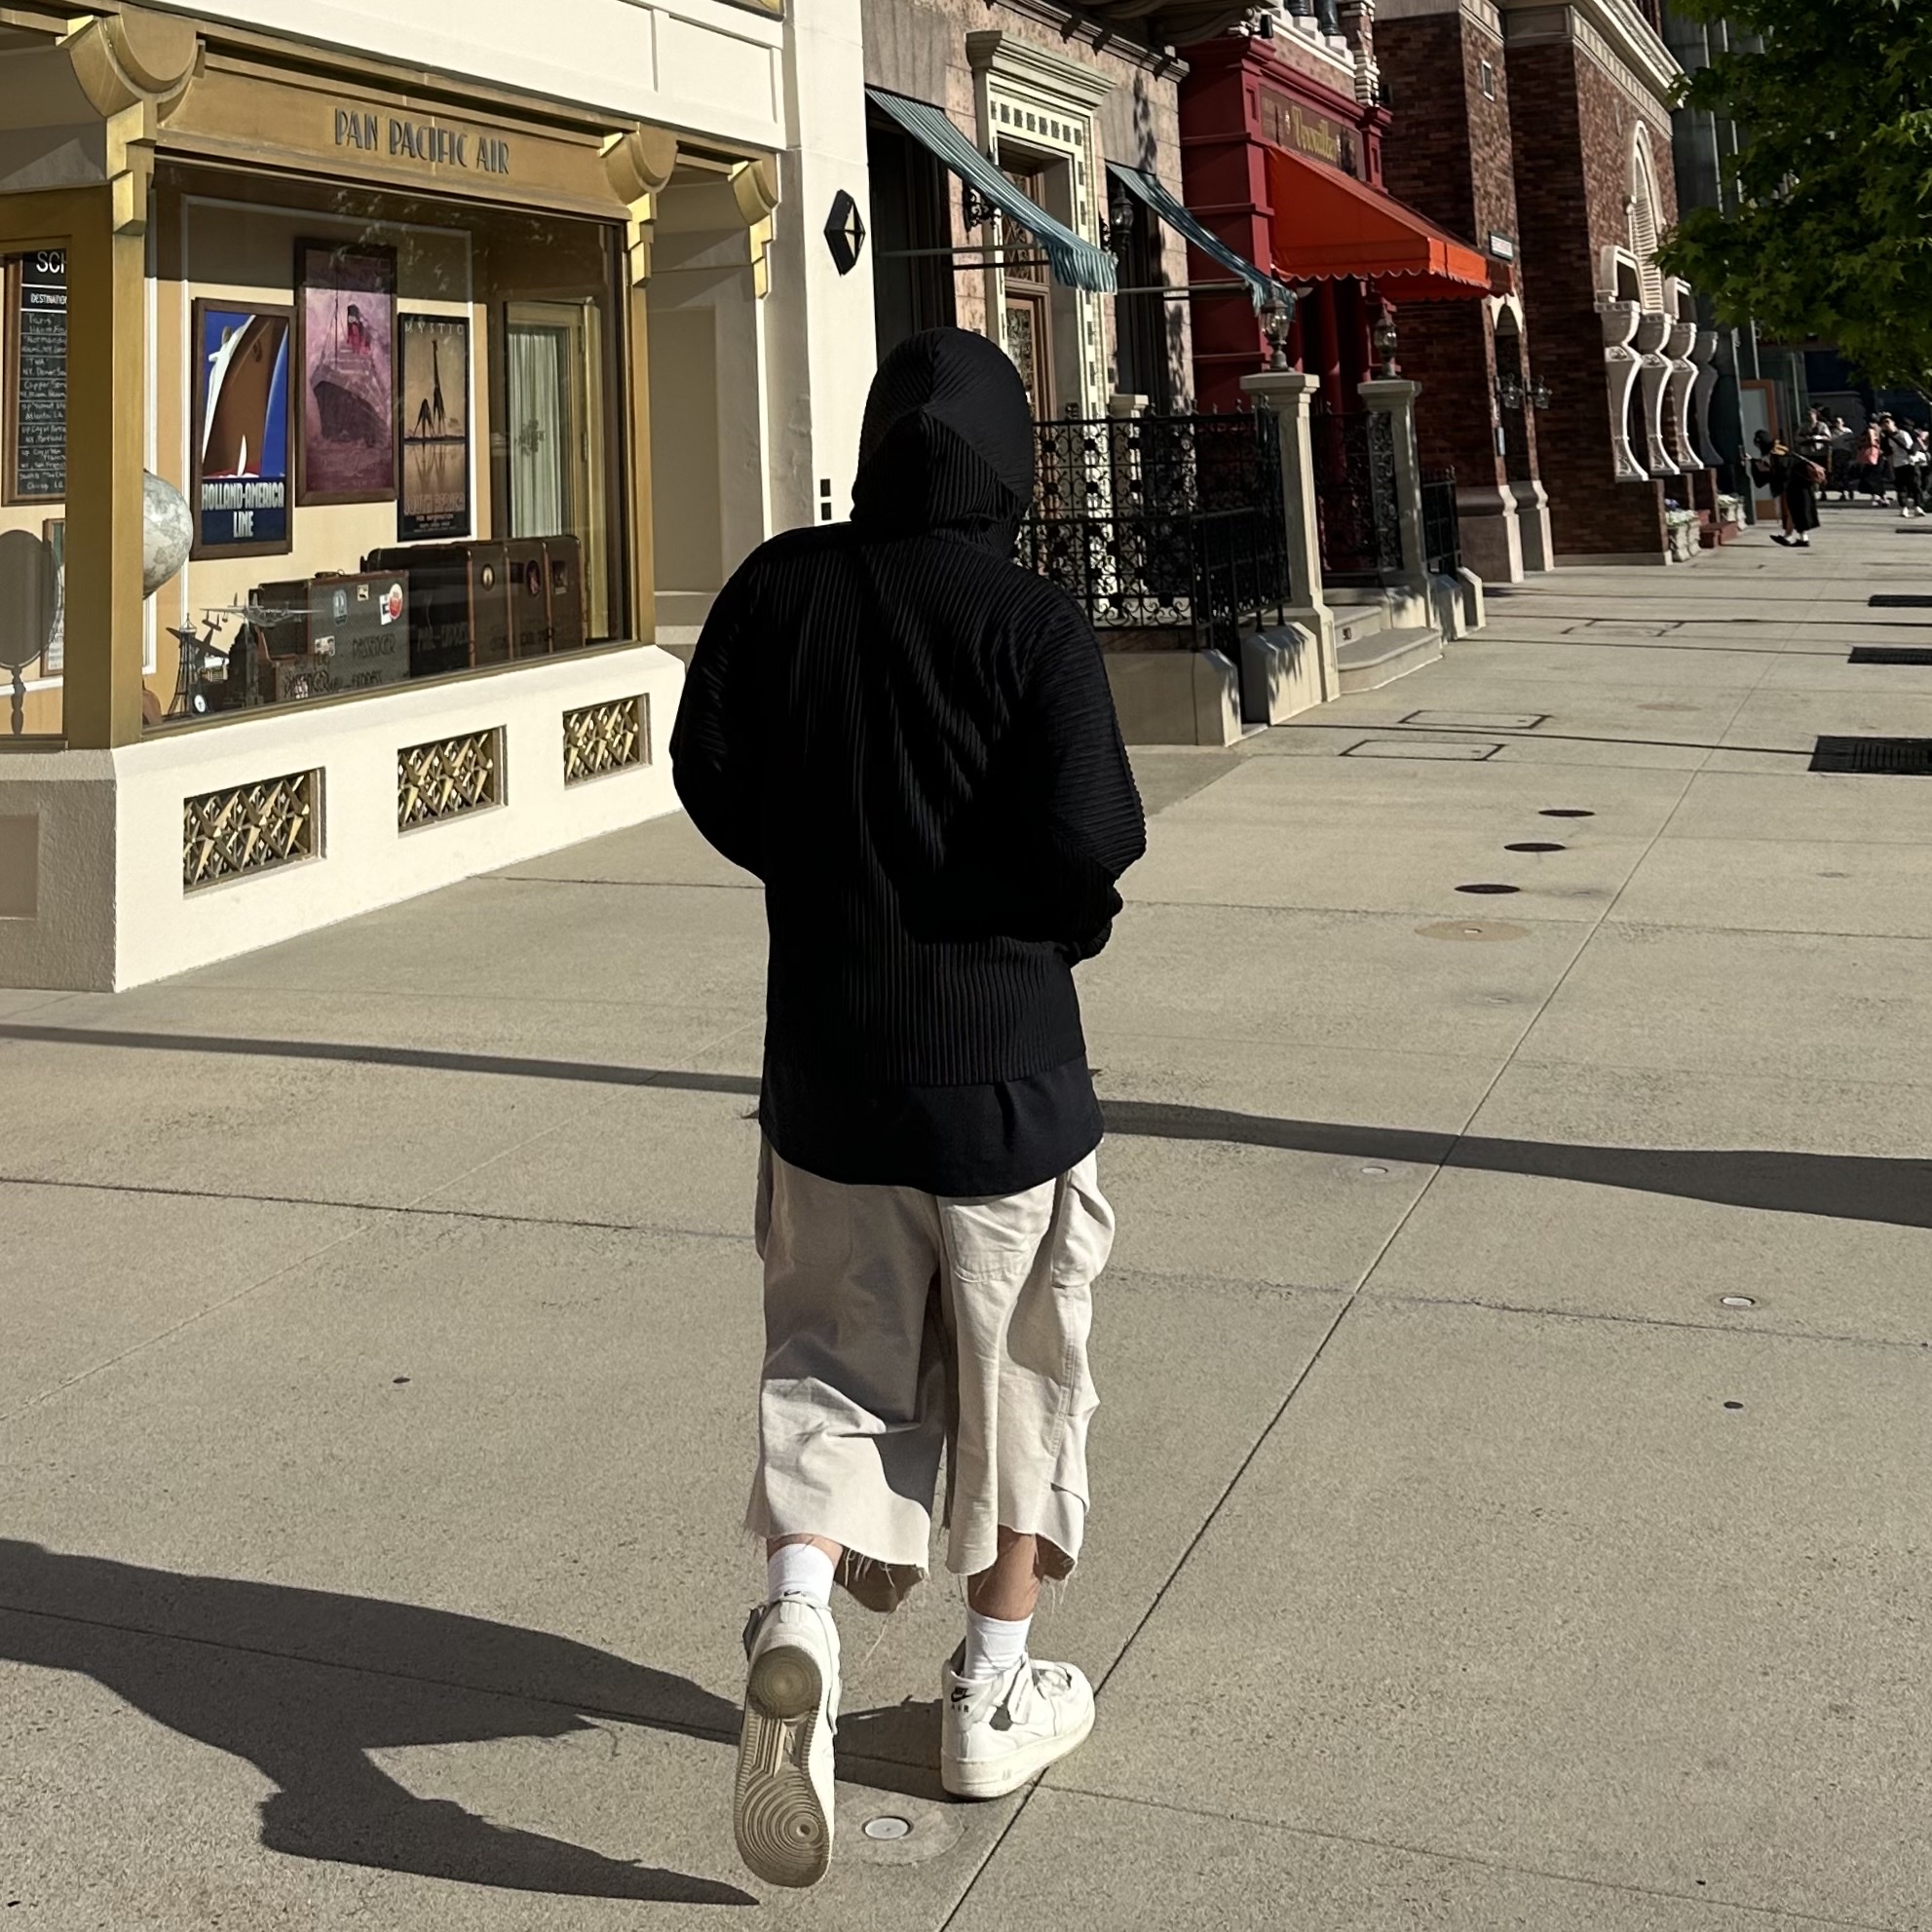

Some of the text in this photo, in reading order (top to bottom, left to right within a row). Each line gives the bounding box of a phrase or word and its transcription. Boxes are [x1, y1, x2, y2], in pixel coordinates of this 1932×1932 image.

[335, 108, 509, 174] PAN PACIFIC AIR
[404, 322, 464, 335] MYSTIC
[202, 481, 284, 511] HOLLAND-AMERICA
[234, 511, 253, 538] LINE
